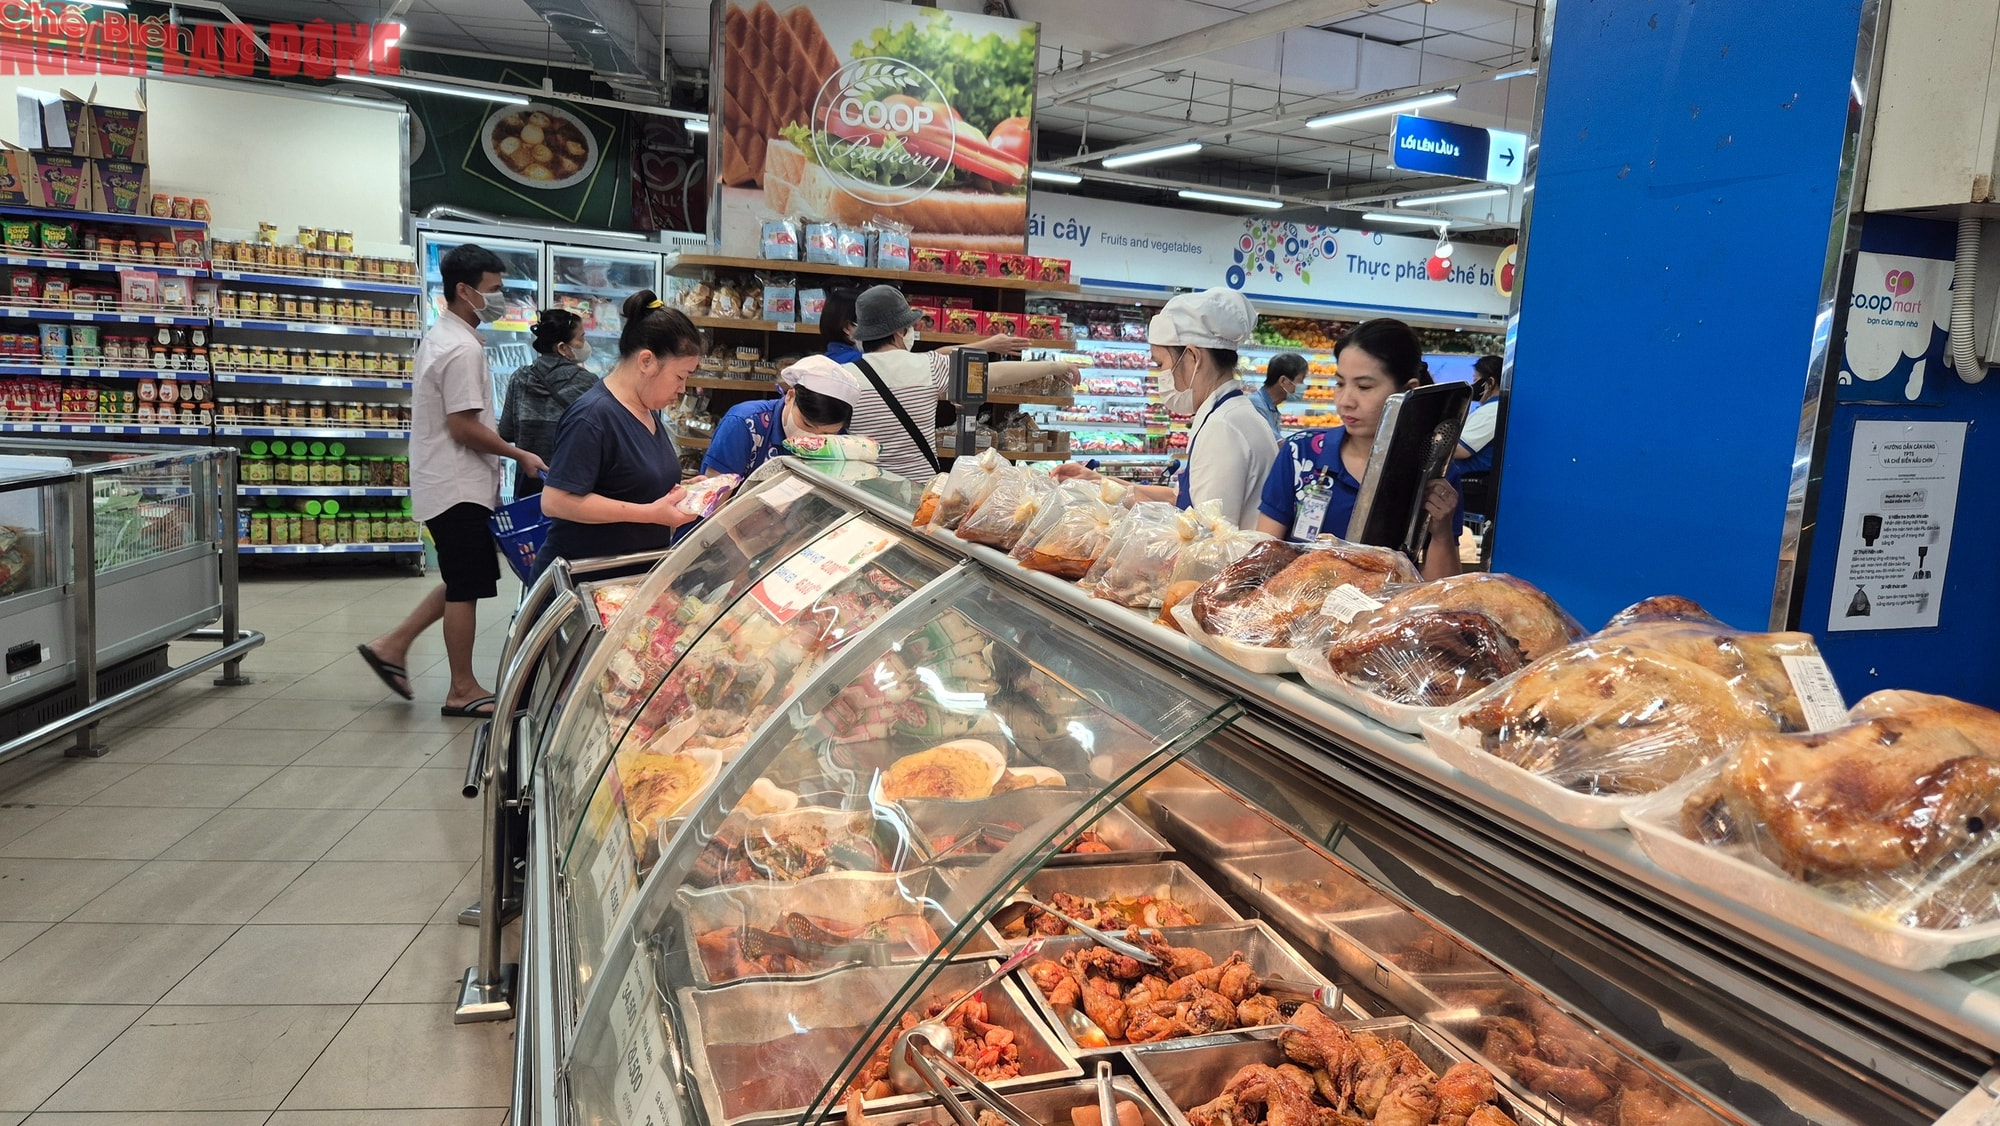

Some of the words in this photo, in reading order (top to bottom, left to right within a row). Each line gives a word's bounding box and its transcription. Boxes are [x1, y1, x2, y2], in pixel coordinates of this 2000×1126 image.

[104, 13, 194, 53] Biến
[839, 97, 935, 134] CO.OP
[829, 134, 942, 171] Bakery
[1401, 134, 1416, 150] LỐI
[1417, 137, 1435, 153] LÊN
[1435, 138, 1453, 156] LẦU
[1052, 217, 1091, 247] cây
[1100, 232, 1128, 247] Fruits
[1130, 237, 1149, 249] and
[1150, 239, 1202, 255] vegetables
[1346, 254, 1391, 281] Thực
[1395, 257, 1429, 283] phẩ
[1447, 263, 1477, 285] chế
[1867, 317, 1880, 326] bạn
[1881, 318, 1893, 326] của
[1894, 319, 1905, 328] mọi
[1892, 300, 1922, 314] mart
[621, 977, 637, 1030] 34.500
[627, 1033, 643, 1103] 29.500
